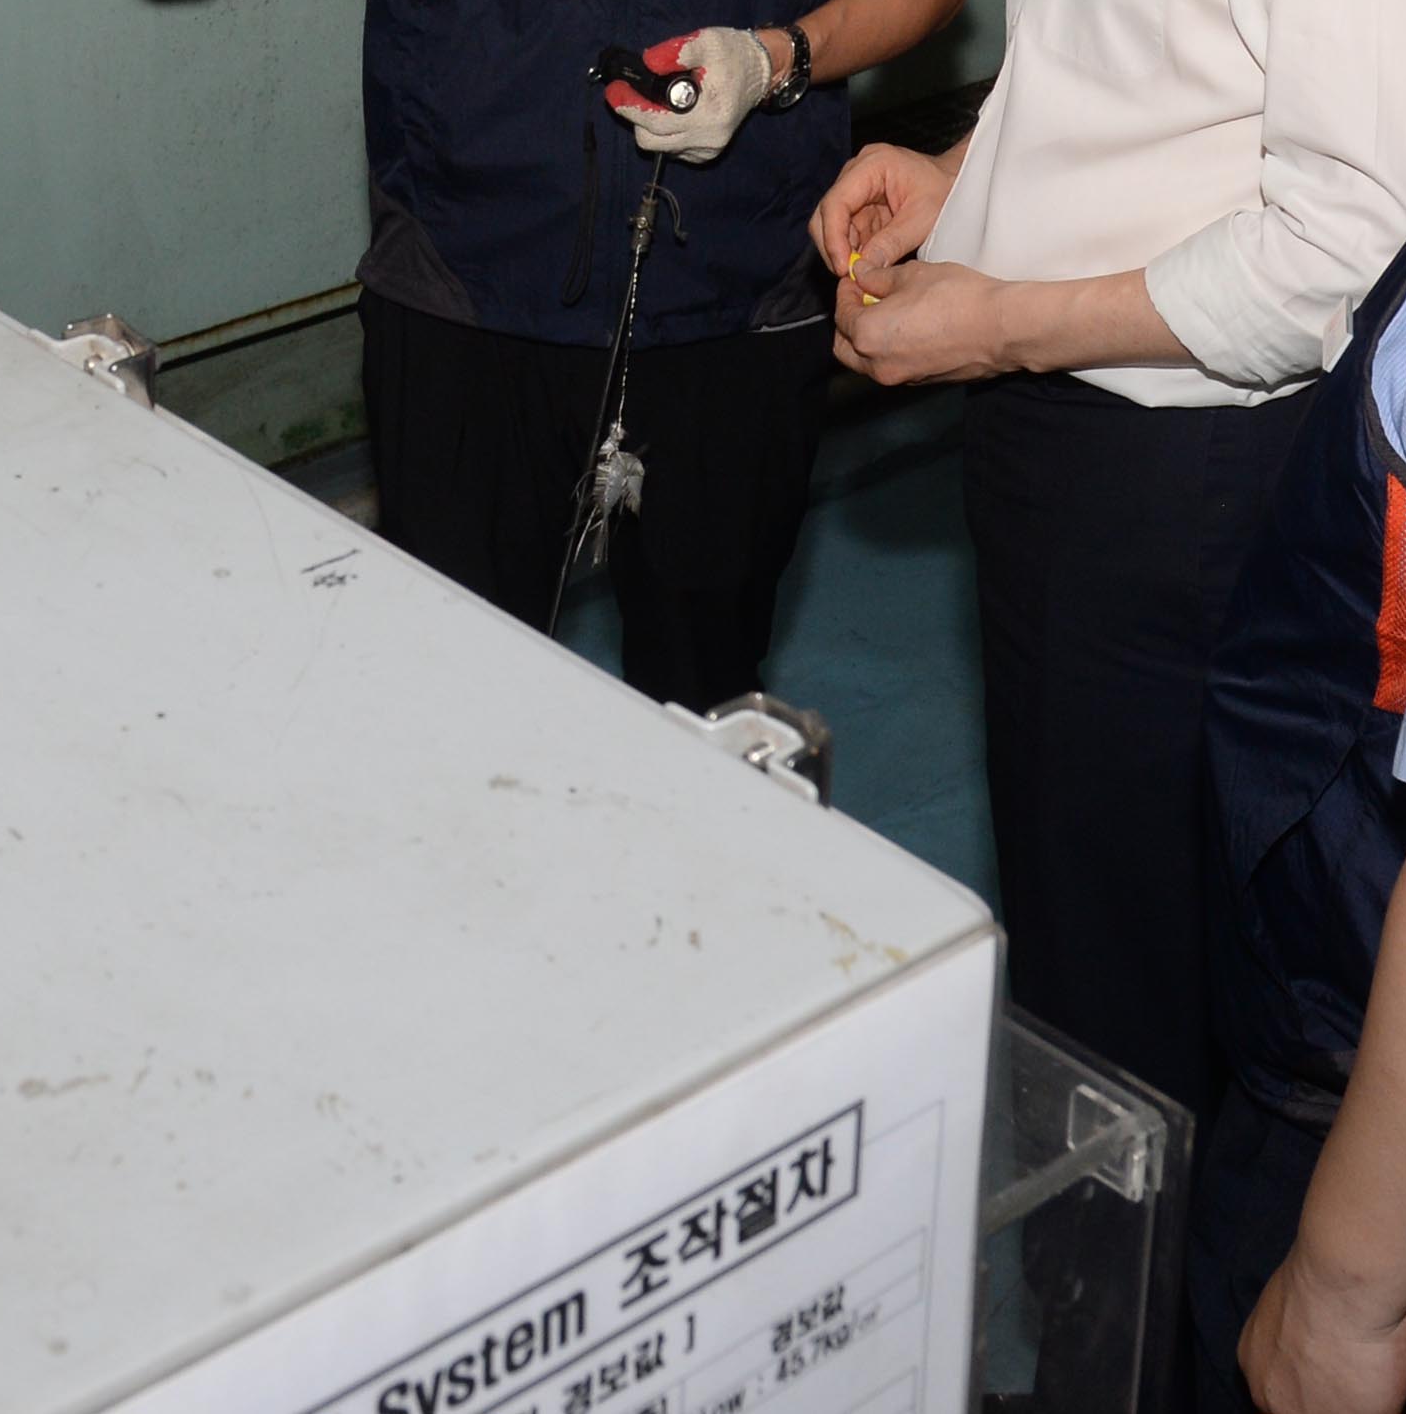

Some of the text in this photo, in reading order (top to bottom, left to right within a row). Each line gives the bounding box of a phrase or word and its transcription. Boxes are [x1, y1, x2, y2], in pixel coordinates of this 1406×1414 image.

[377, 1133, 838, 1414] System 조작절차
[770, 1283, 846, 1355] 경보값
